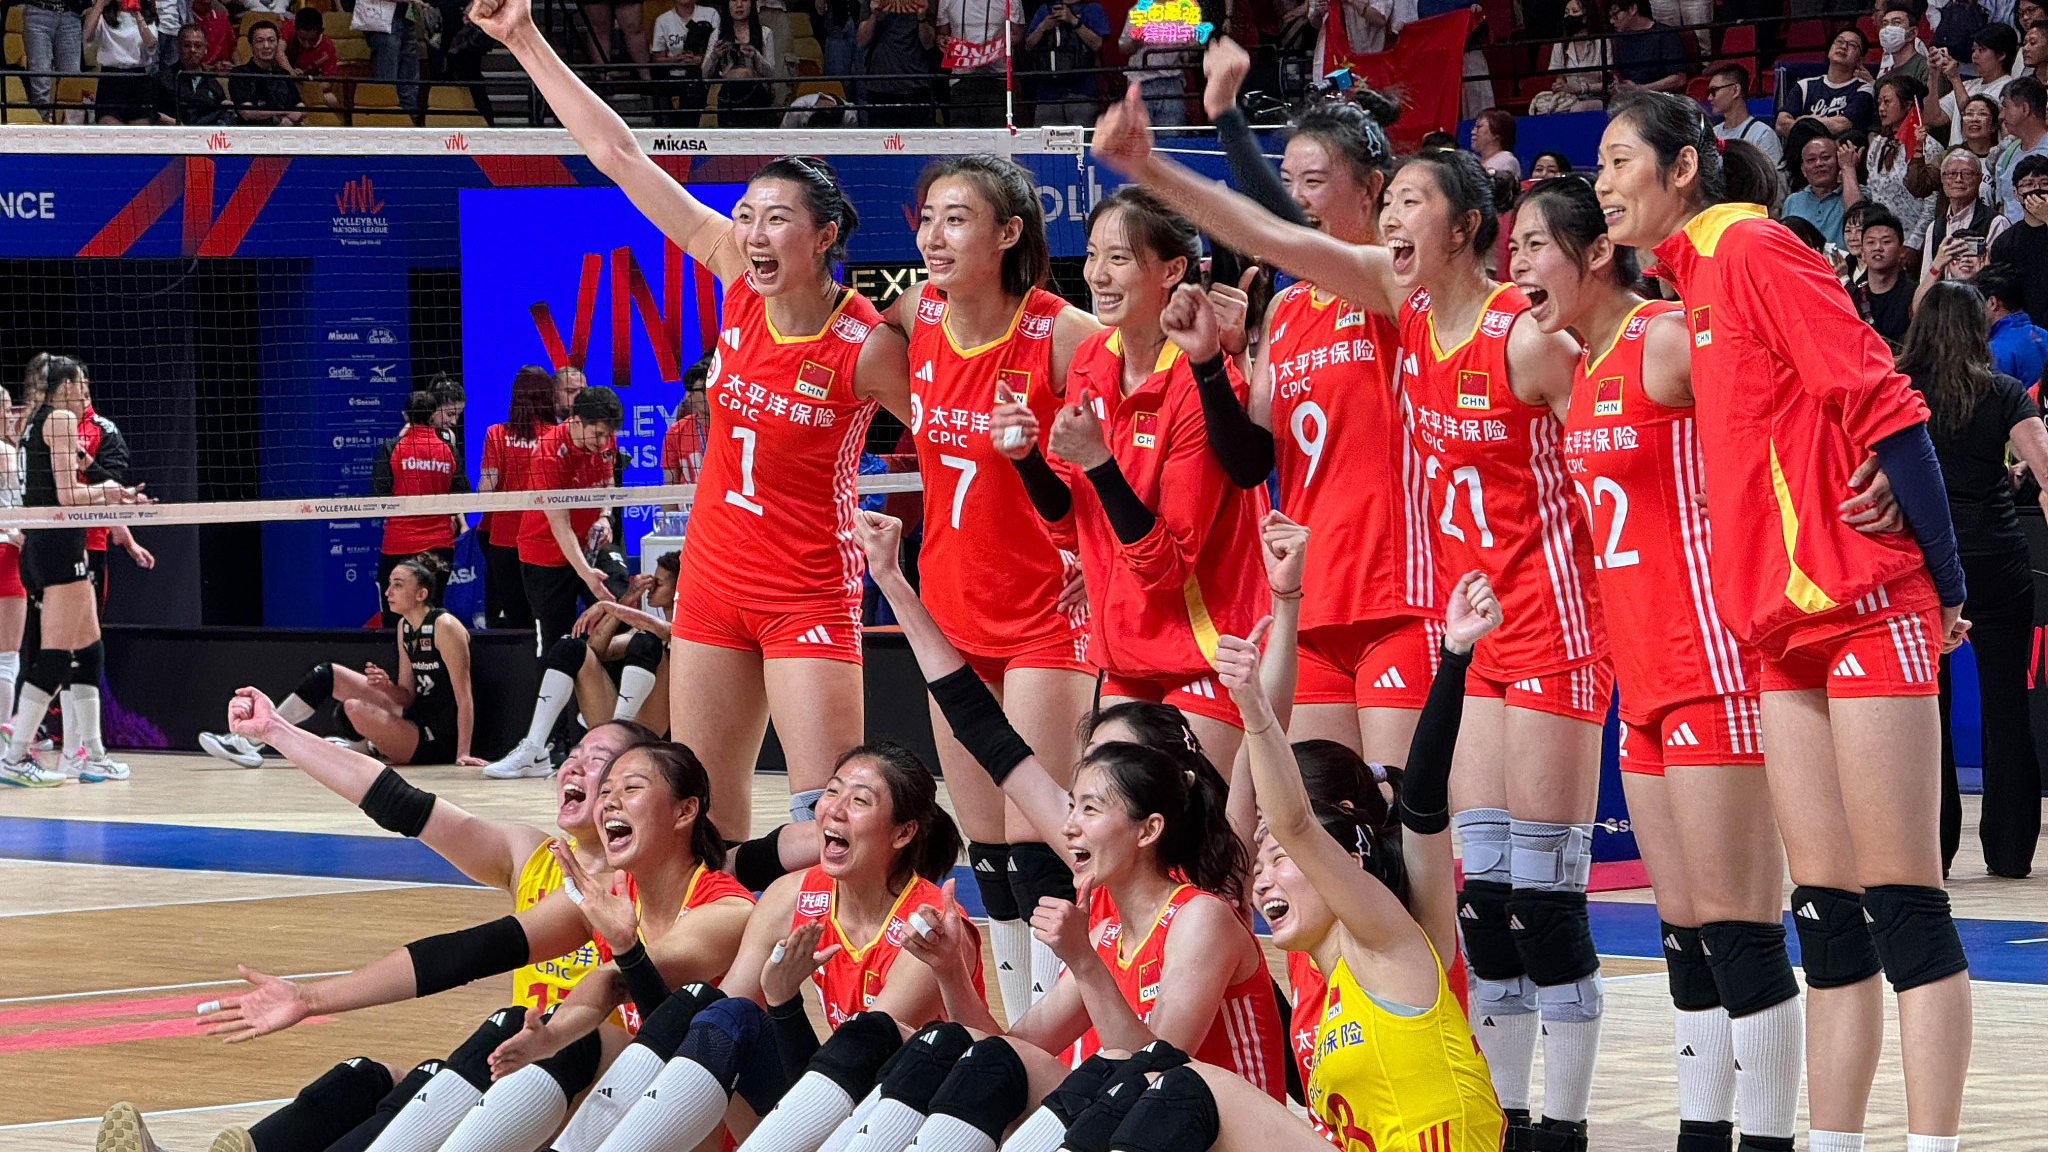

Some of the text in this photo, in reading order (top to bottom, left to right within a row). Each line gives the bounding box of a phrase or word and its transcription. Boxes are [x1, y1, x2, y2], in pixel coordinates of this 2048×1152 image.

[332, 217, 389, 226] VOLLEYBALL
[834, 316, 869, 339] 光明
[1696, 333, 1710, 344] CHN
[1279, 339, 1375, 381] 太平洋保险
[799, 383, 825, 397] CHN
[1280, 376, 1311, 399] CPIC
[718, 393, 760, 422] CPIC
[722, 374, 836, 428] 太平洋保险
[1461, 396, 1486, 407] CHN
[1596, 402, 1618, 413] CHN
[1418, 405, 1508, 442] 太平洋保险
[928, 430, 967, 448] CPIC
[1137, 435, 1153, 446] CH
[1290, 401, 1327, 489] 9
[1422, 429, 1446, 453] CPIC
[1564, 426, 1639, 455] 太平洋保险
[402, 456, 451, 474] TÜRKİYE
[731, 426, 756, 497] 1
[1565, 458, 1588, 474] CPIC
[547, 495, 592, 504] VOLLEYBALL
[940, 454, 977, 530] 7
[68, 512, 117, 521] VOLLEYBALL
[315, 503, 362, 512] VOLLEYBALL
[800, 893, 829, 908] 光明
